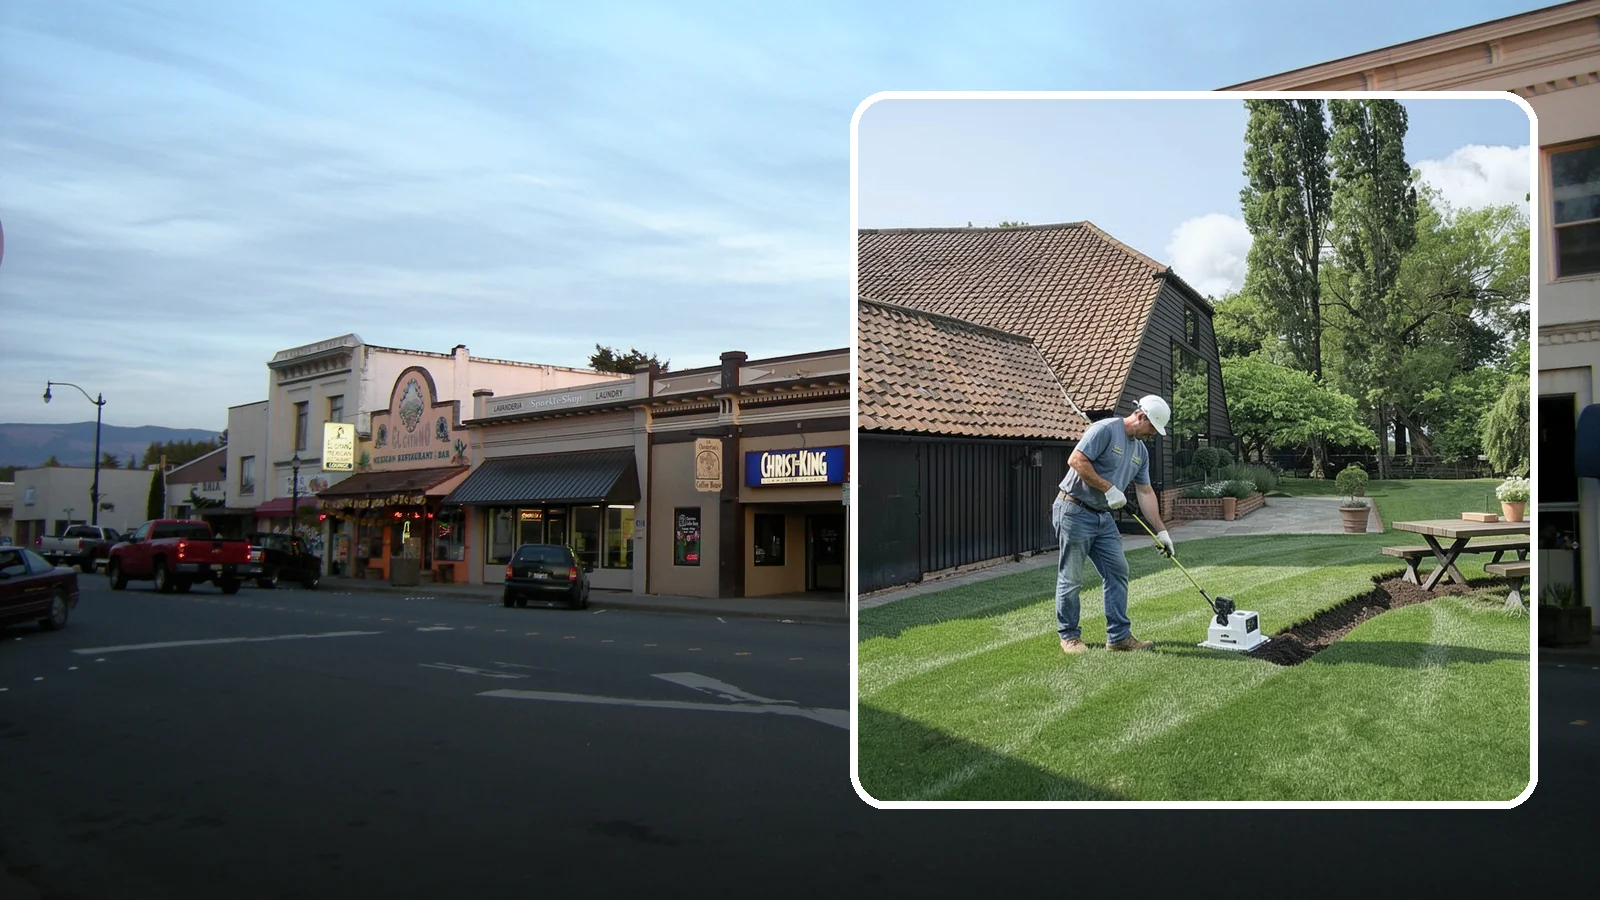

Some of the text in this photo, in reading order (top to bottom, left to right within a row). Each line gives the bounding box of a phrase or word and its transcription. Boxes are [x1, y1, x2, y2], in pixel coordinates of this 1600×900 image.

[595, 389, 623, 400] LAUNDRY
[493, 402, 522, 413] LAVANDERIA
[373, 450, 450, 464] MEXICAN RESTAURANT BAR
[799, 450, 827, 476] KING
